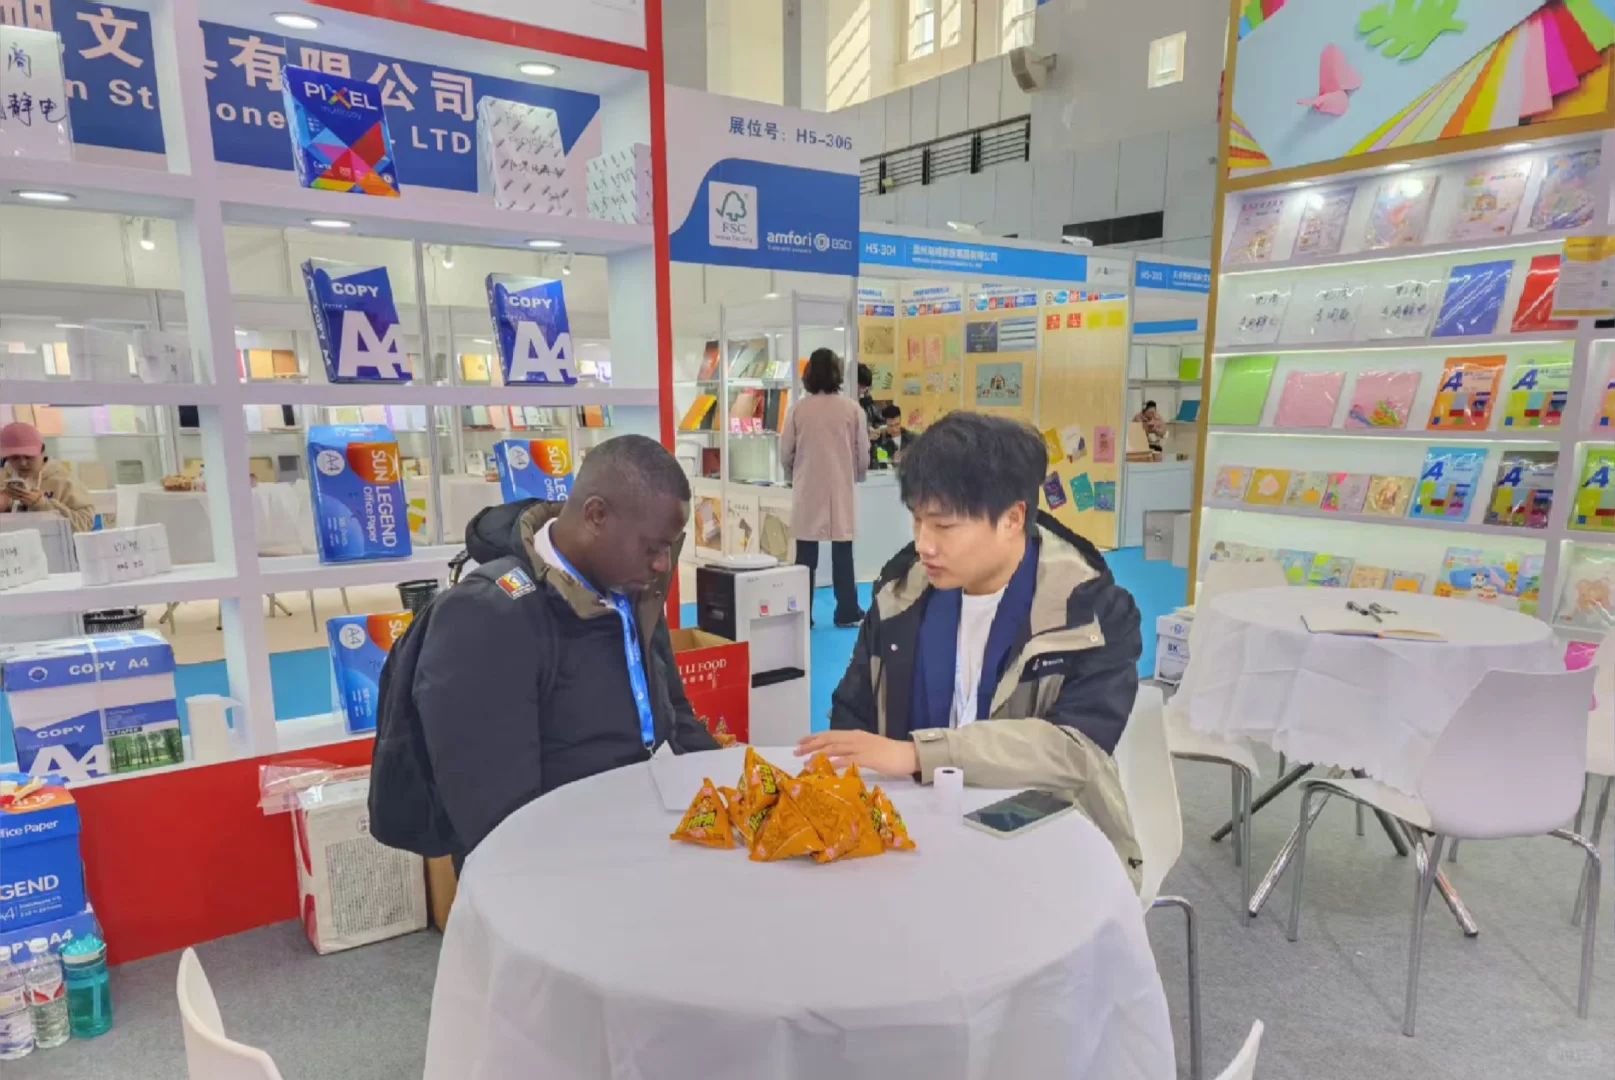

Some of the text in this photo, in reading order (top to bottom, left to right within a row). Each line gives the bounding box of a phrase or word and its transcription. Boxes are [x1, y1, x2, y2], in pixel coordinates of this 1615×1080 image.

[303, 81, 378, 110] PIXEL
[411, 125, 472, 154] LTD
[796, 128, 853, 150] H5-306
[722, 221, 747, 235] FSC
[767, 230, 812, 247] amfori
[331, 282, 380, 298] COPY
[508, 295, 553, 309] COPY
[338, 310, 409, 379] A4
[508, 320, 574, 383] A4
[547, 445, 569, 502] SUN LEG
[371, 450, 397, 547] SUN LEGEND
[363, 486, 378, 543] Office Paper
[69, 656, 150, 676] COPY A4
[698, 658, 727, 673] FOOD
[36, 724, 86, 740] COPY
[24, 819, 59, 835] Paper
[0, 874, 60, 901] GEND
[49, 929, 74, 945] A4
